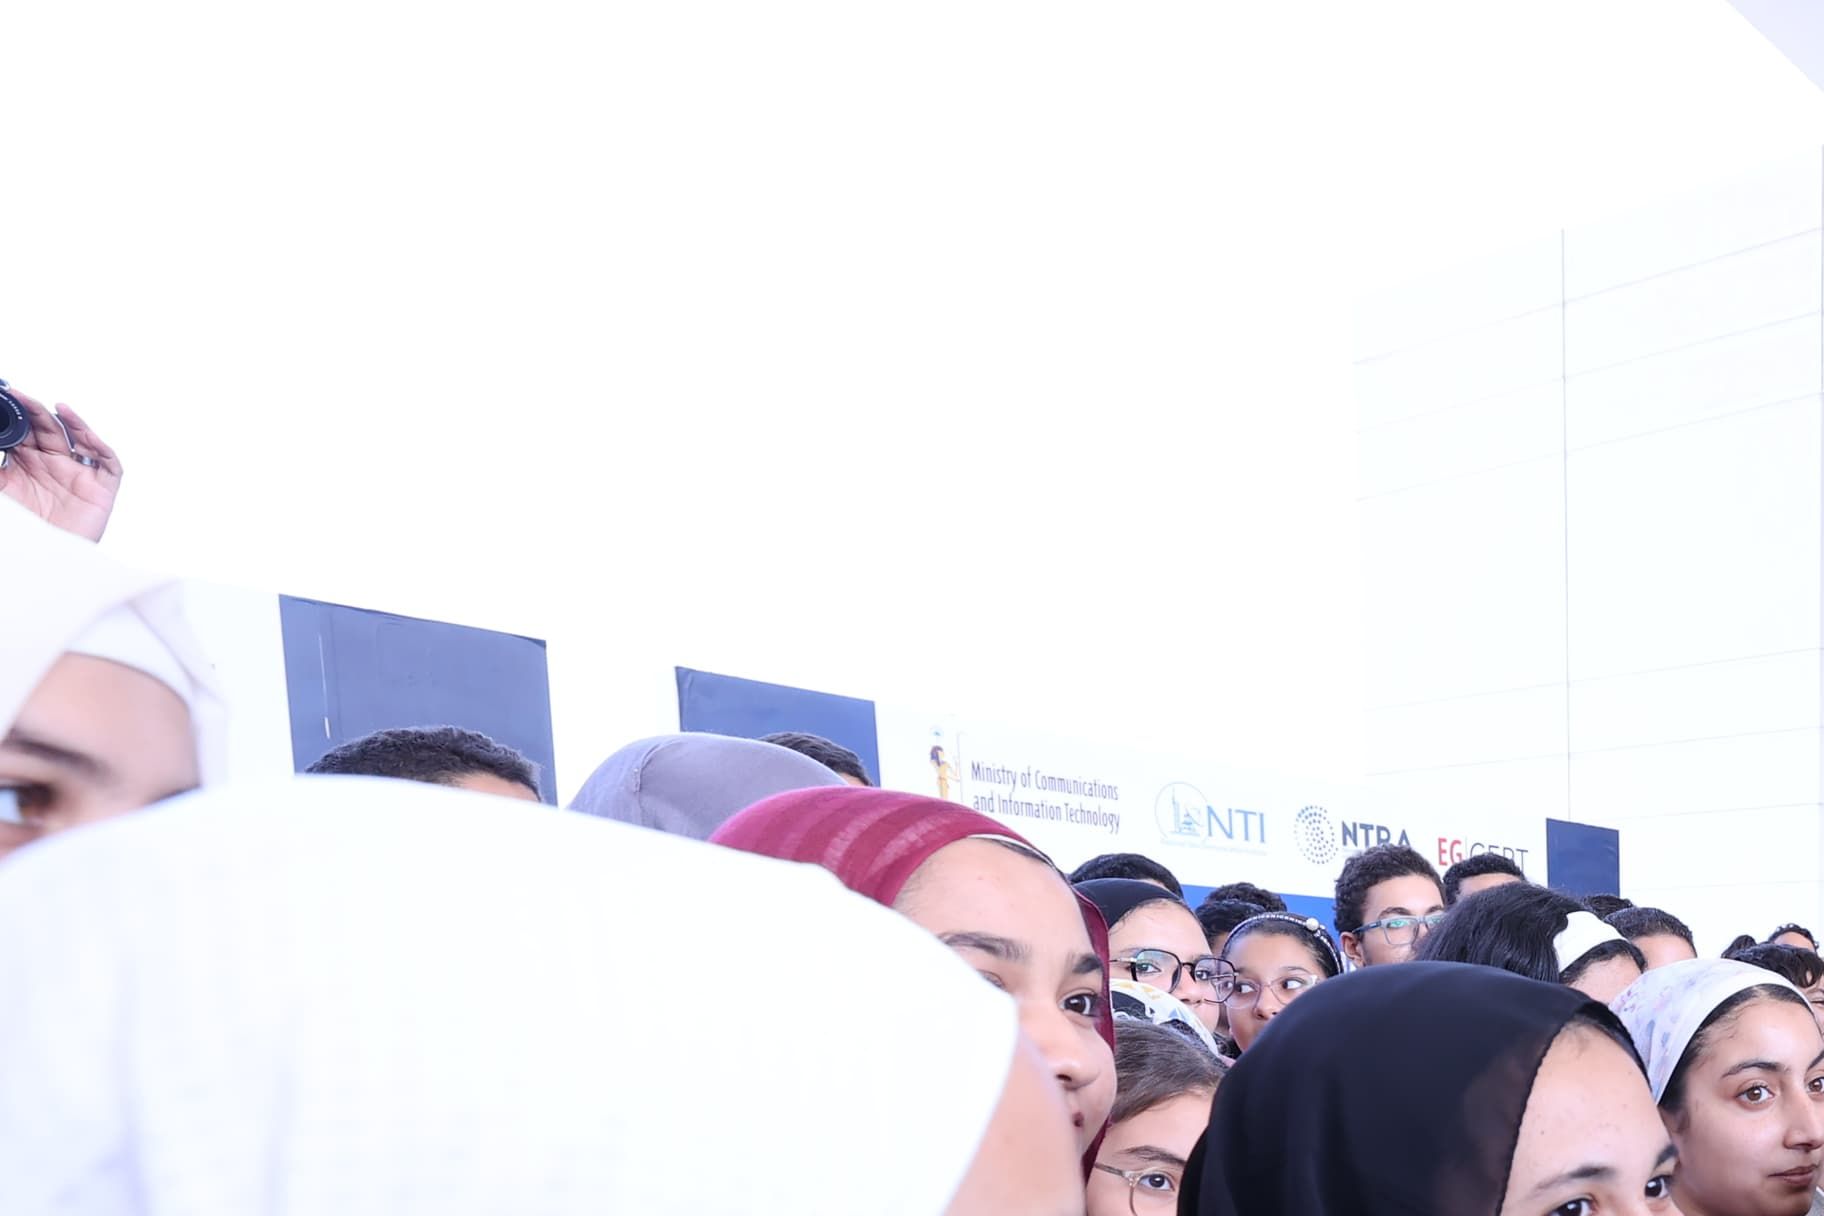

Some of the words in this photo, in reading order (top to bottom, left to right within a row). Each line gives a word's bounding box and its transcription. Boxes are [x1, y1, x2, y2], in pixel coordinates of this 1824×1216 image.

[971, 760, 1017, 793] Ministry
[1020, 767, 1034, 790] of
[1035, 769, 1119, 801] Communications
[973, 793, 995, 814] and
[998, 793, 1062, 822] Information
[1064, 802, 1121, 835] Technology
[1206, 804, 1267, 844] NTI
[1342, 820, 1411, 848] NTRA
[1438, 837, 1463, 866] EG
